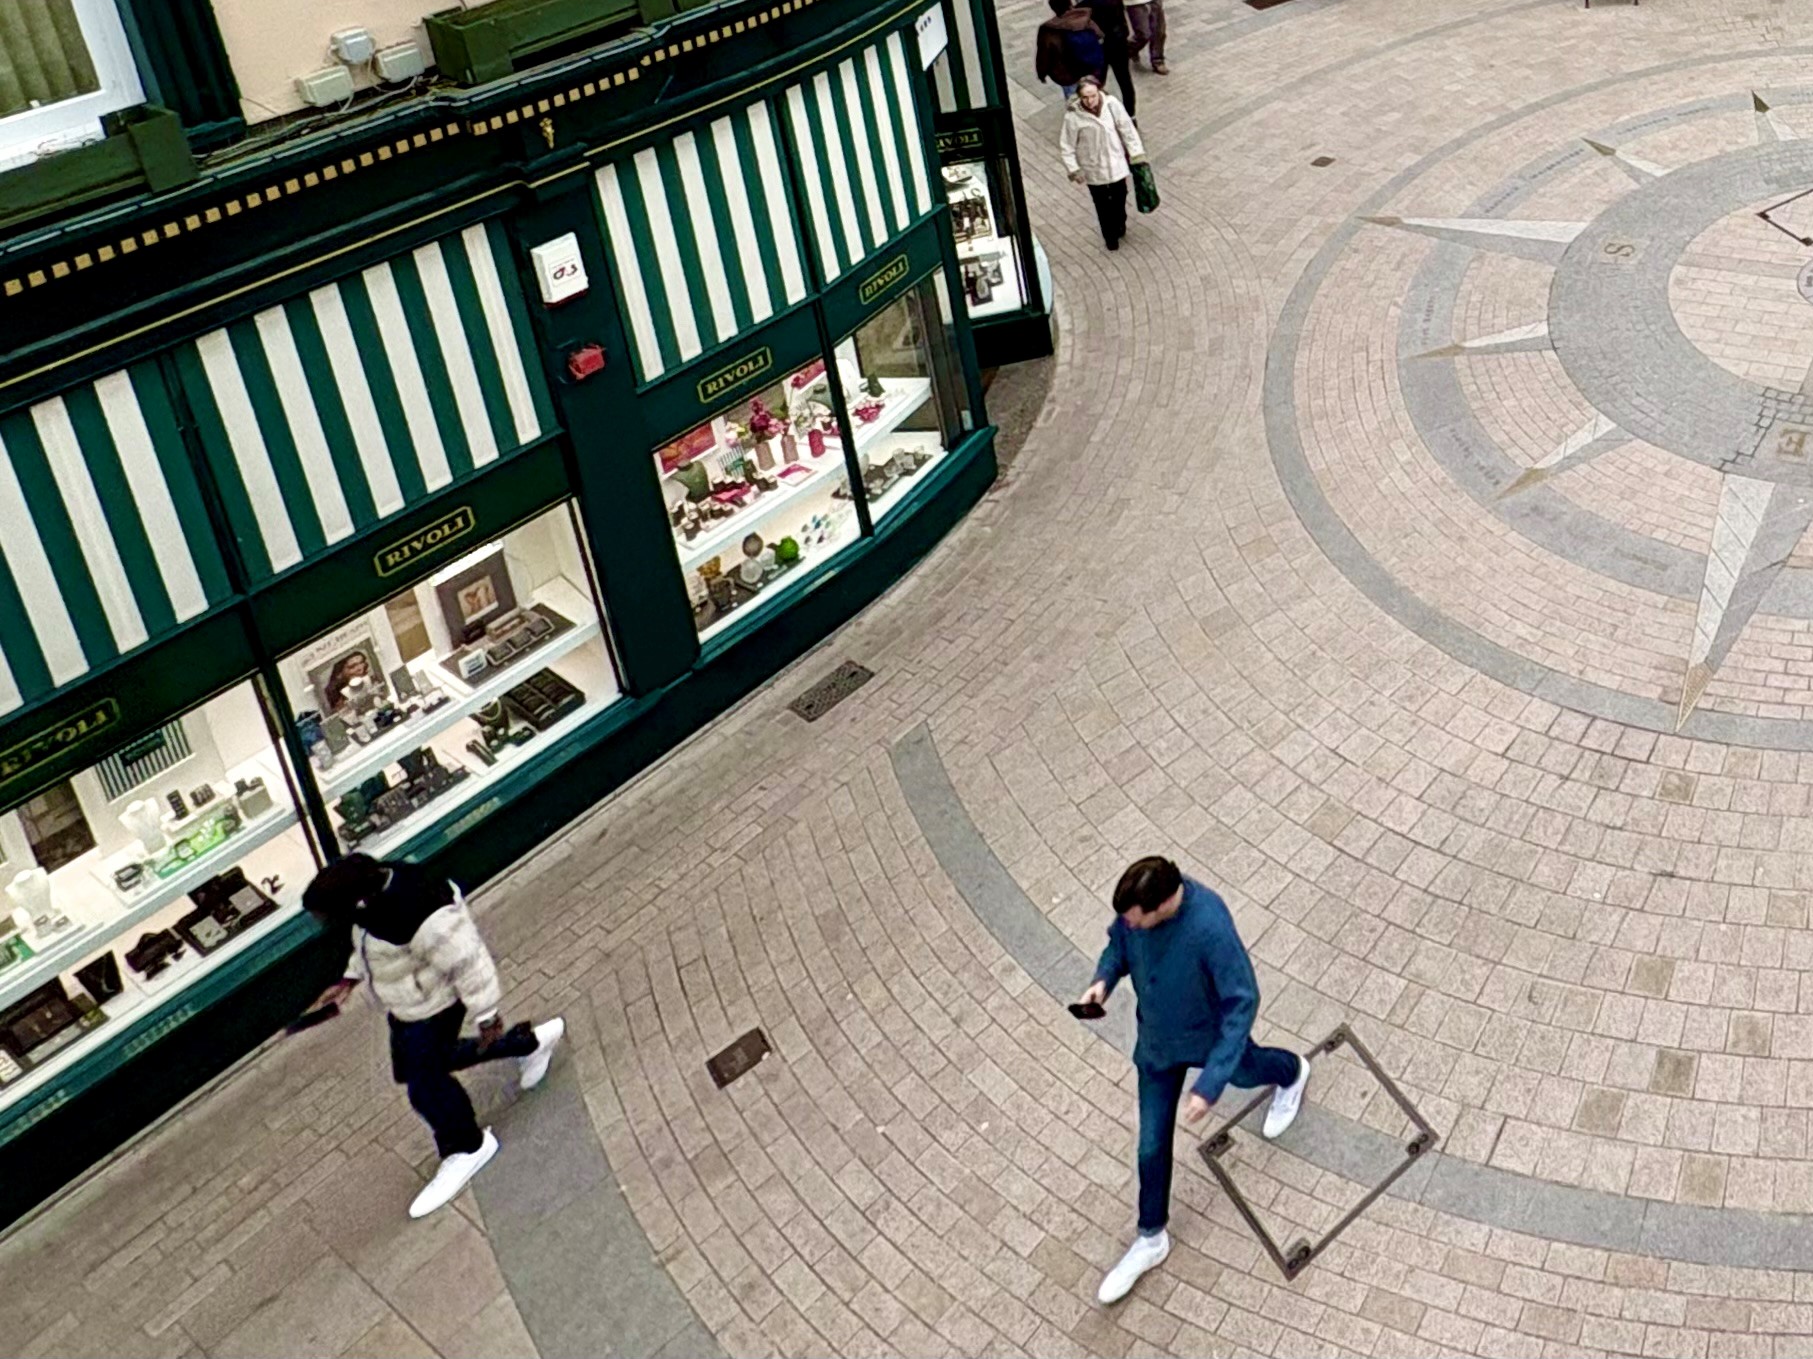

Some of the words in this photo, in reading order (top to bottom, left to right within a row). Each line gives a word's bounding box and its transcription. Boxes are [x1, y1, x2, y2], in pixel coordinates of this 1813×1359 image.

[937, 132, 979, 148] IVOLI
[1604, 243, 1635, 257] S
[864, 261, 905, 298] RIVOLI
[704, 354, 765, 395] RIVOLI
[384, 515, 466, 568] RIVOLI
[0, 709, 109, 777] RIVOLI
